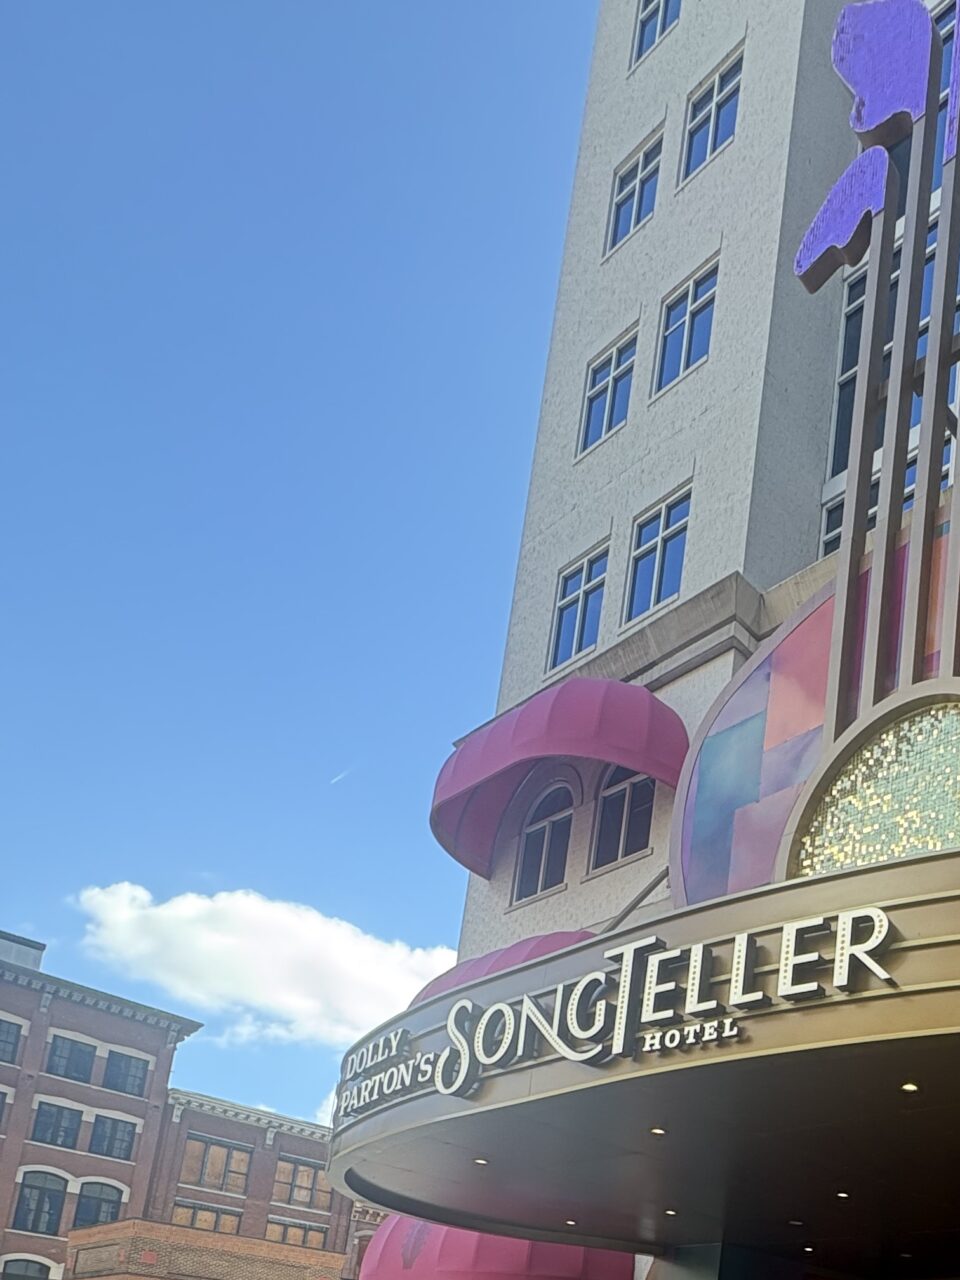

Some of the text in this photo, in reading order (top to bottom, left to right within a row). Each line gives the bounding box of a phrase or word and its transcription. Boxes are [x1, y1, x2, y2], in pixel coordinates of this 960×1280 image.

[434, 906, 893, 1096] SONGTELLER
[345, 1028, 404, 1080] DOLLY
[642, 1017, 738, 1052] HOTEL
[338, 1051, 435, 1117] PARTON'S
